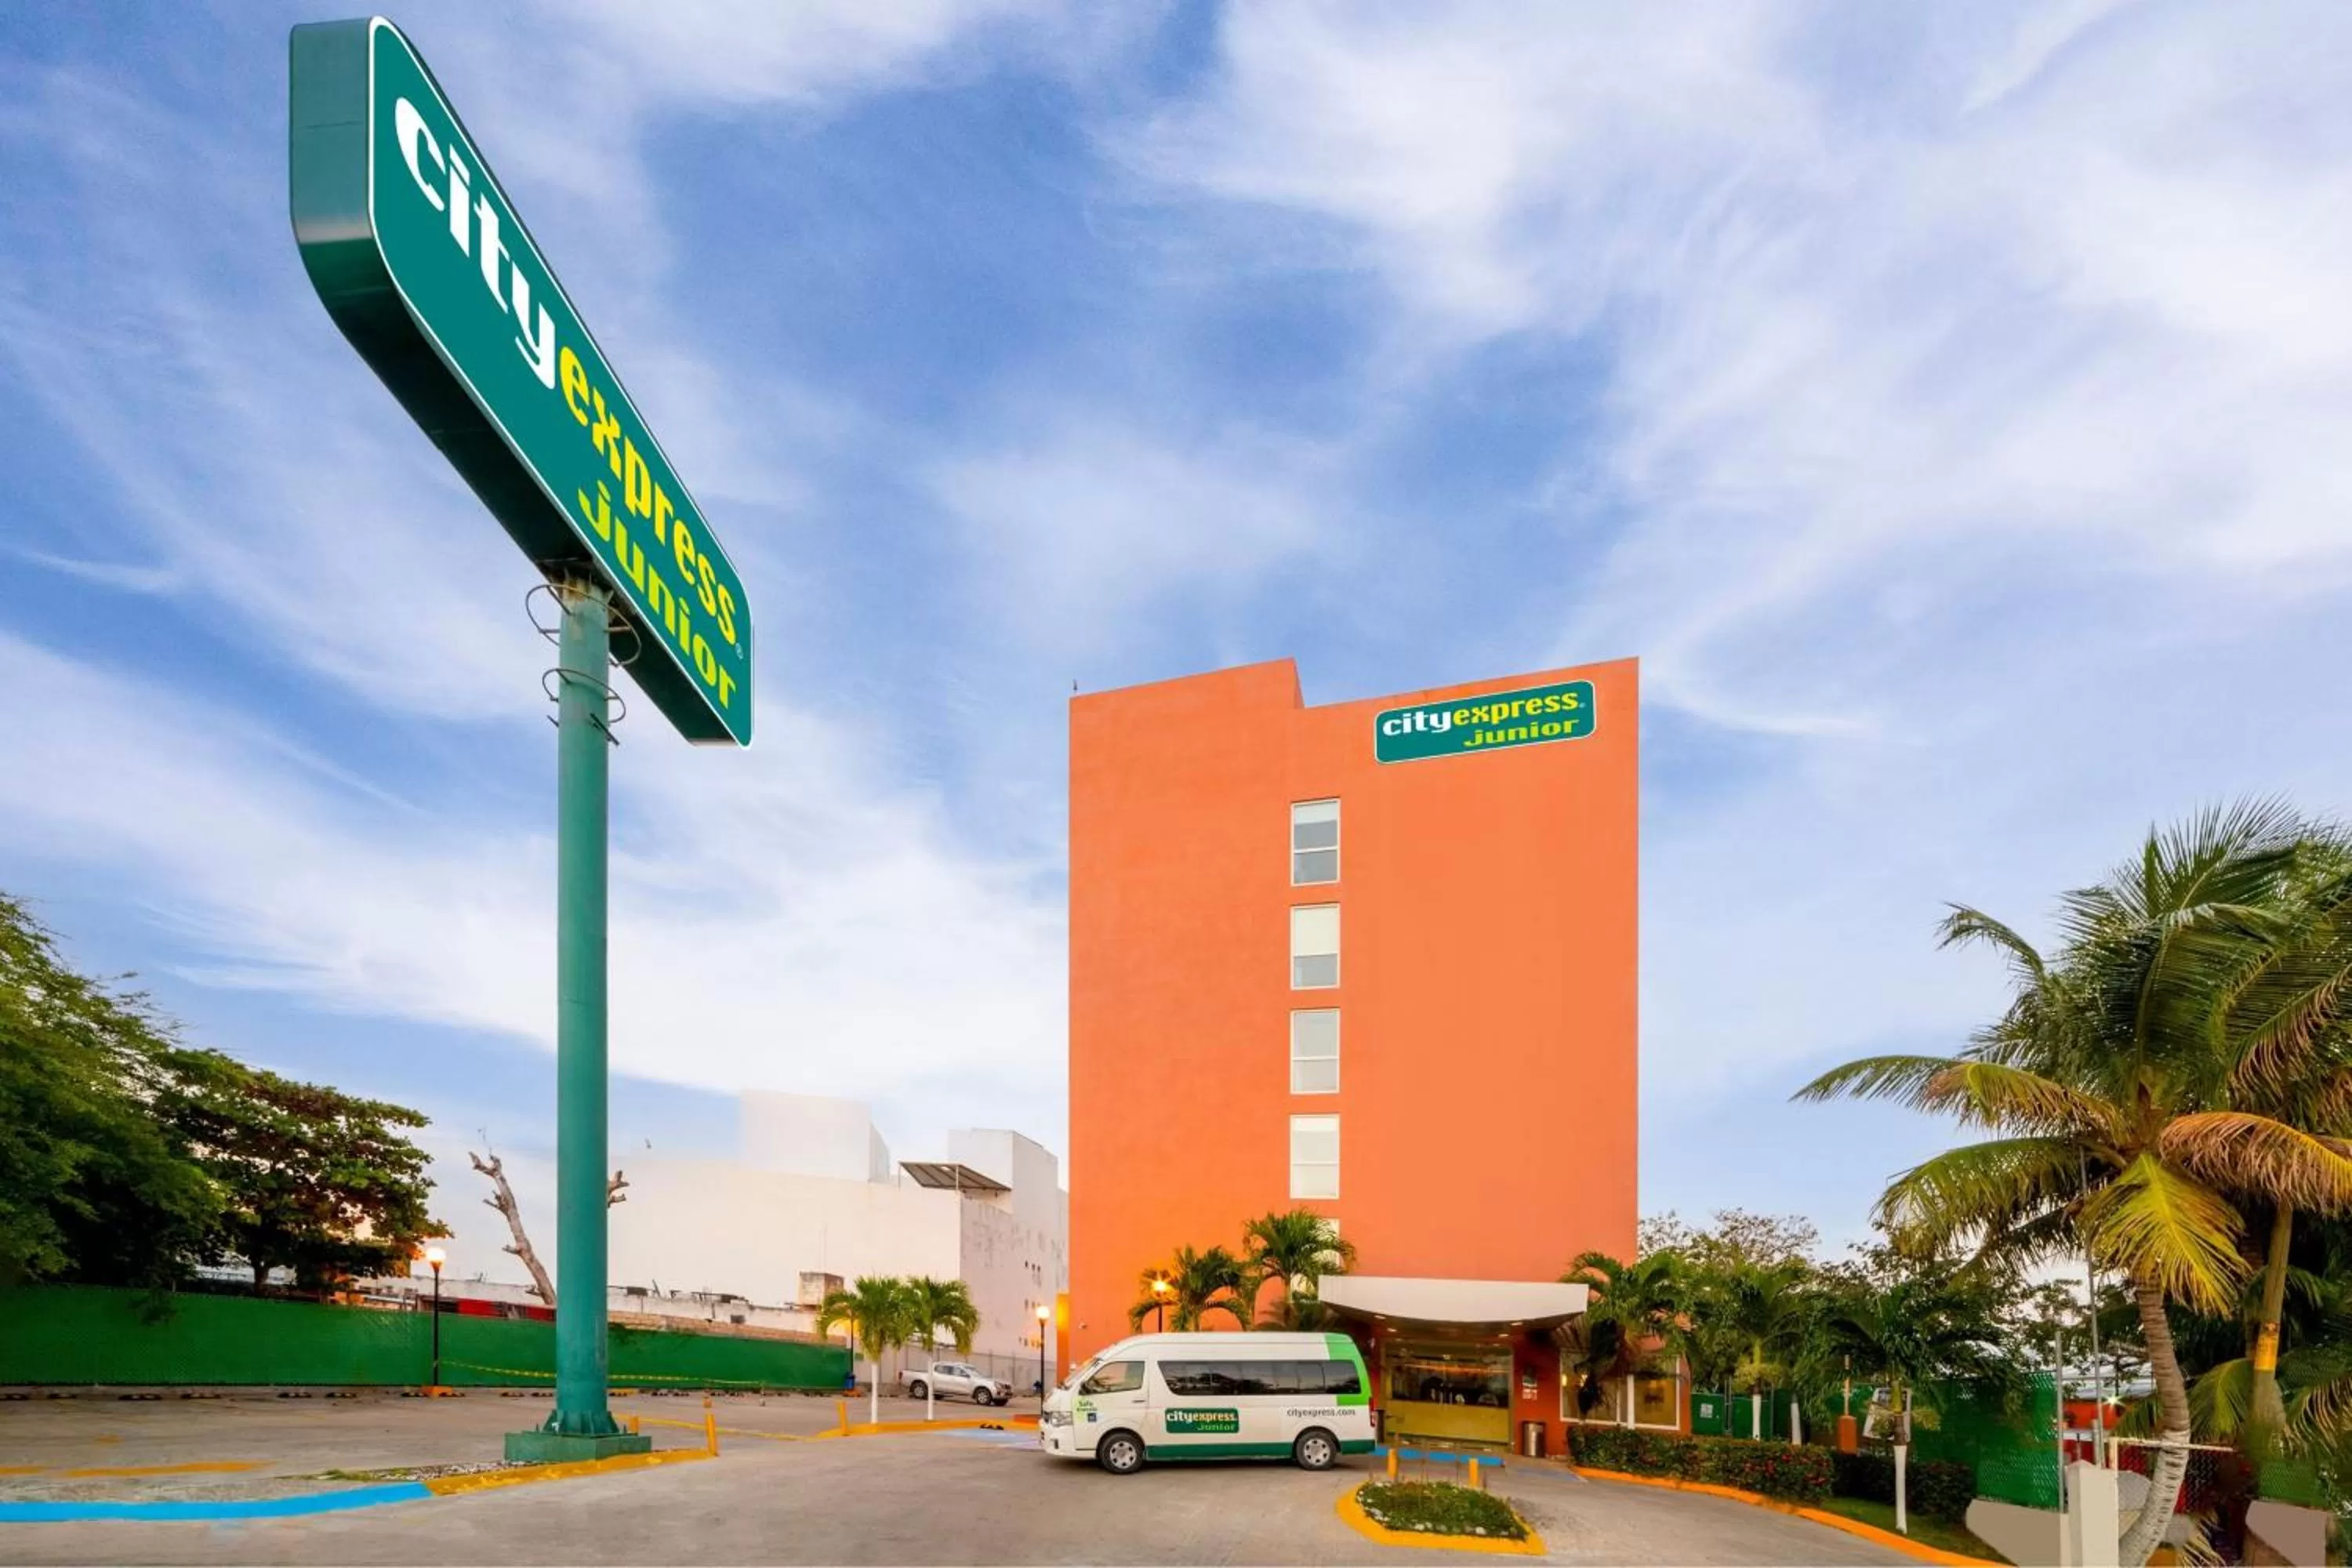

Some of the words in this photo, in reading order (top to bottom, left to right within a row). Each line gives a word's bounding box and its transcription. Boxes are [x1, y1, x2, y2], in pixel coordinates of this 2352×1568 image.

[395, 97, 736, 645] cityexpress
[578, 480, 736, 710] junior
[1382, 691, 1579, 736] cityexpress
[1463, 719, 1580, 747] junior
[1166, 1410, 1235, 1424] cityexpress
[1287, 1408, 1356, 1417] cityexpress.com
